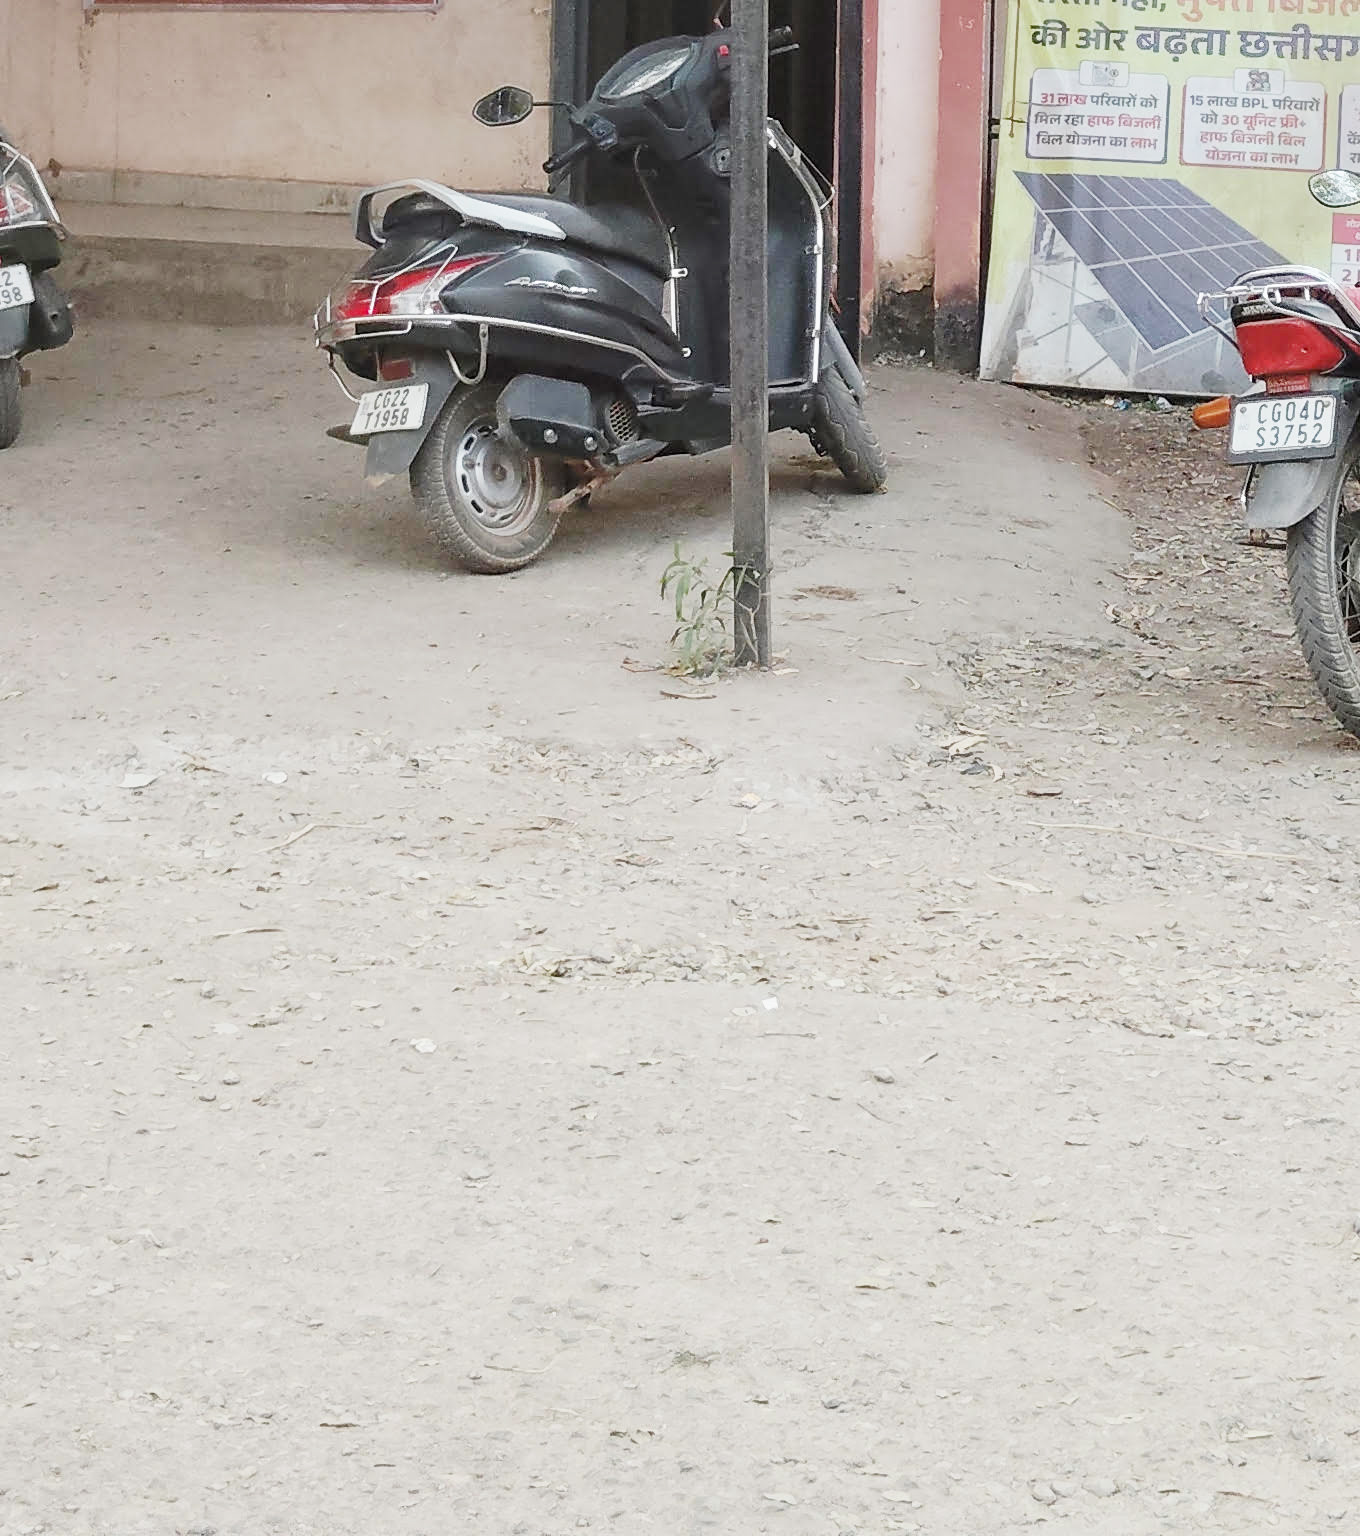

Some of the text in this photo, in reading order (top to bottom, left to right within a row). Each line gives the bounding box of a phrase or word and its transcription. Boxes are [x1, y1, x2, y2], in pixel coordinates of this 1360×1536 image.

[1030, 18, 1070, 50] की
[1075, 20, 1129, 52] ओर
[1134, 25, 1231, 63] बढ़ता
[1040, 92, 1160, 109] 31 लाख परिवारों को
[1190, 95, 1321, 112] 15 लाख BPL परिवारों
[1033, 111, 1163, 130] मिल रहा हाफ बिजली
[1200, 109, 1219, 125] को
[1221, 114, 1240, 126] 30
[1242, 113, 1278, 131] यूनिट
[1036, 130, 1159, 150] बिल योजना का लाभ
[1199, 129, 1307, 147] हाफ बिजली बिल
[1204, 146, 1300, 166] योजना का लाभ
[373, 388, 410, 410] CG22
[365, 408, 410, 430] T1958
[1257, 399, 1325, 425] CG04D
[1255, 422, 1324, 448] S3752
